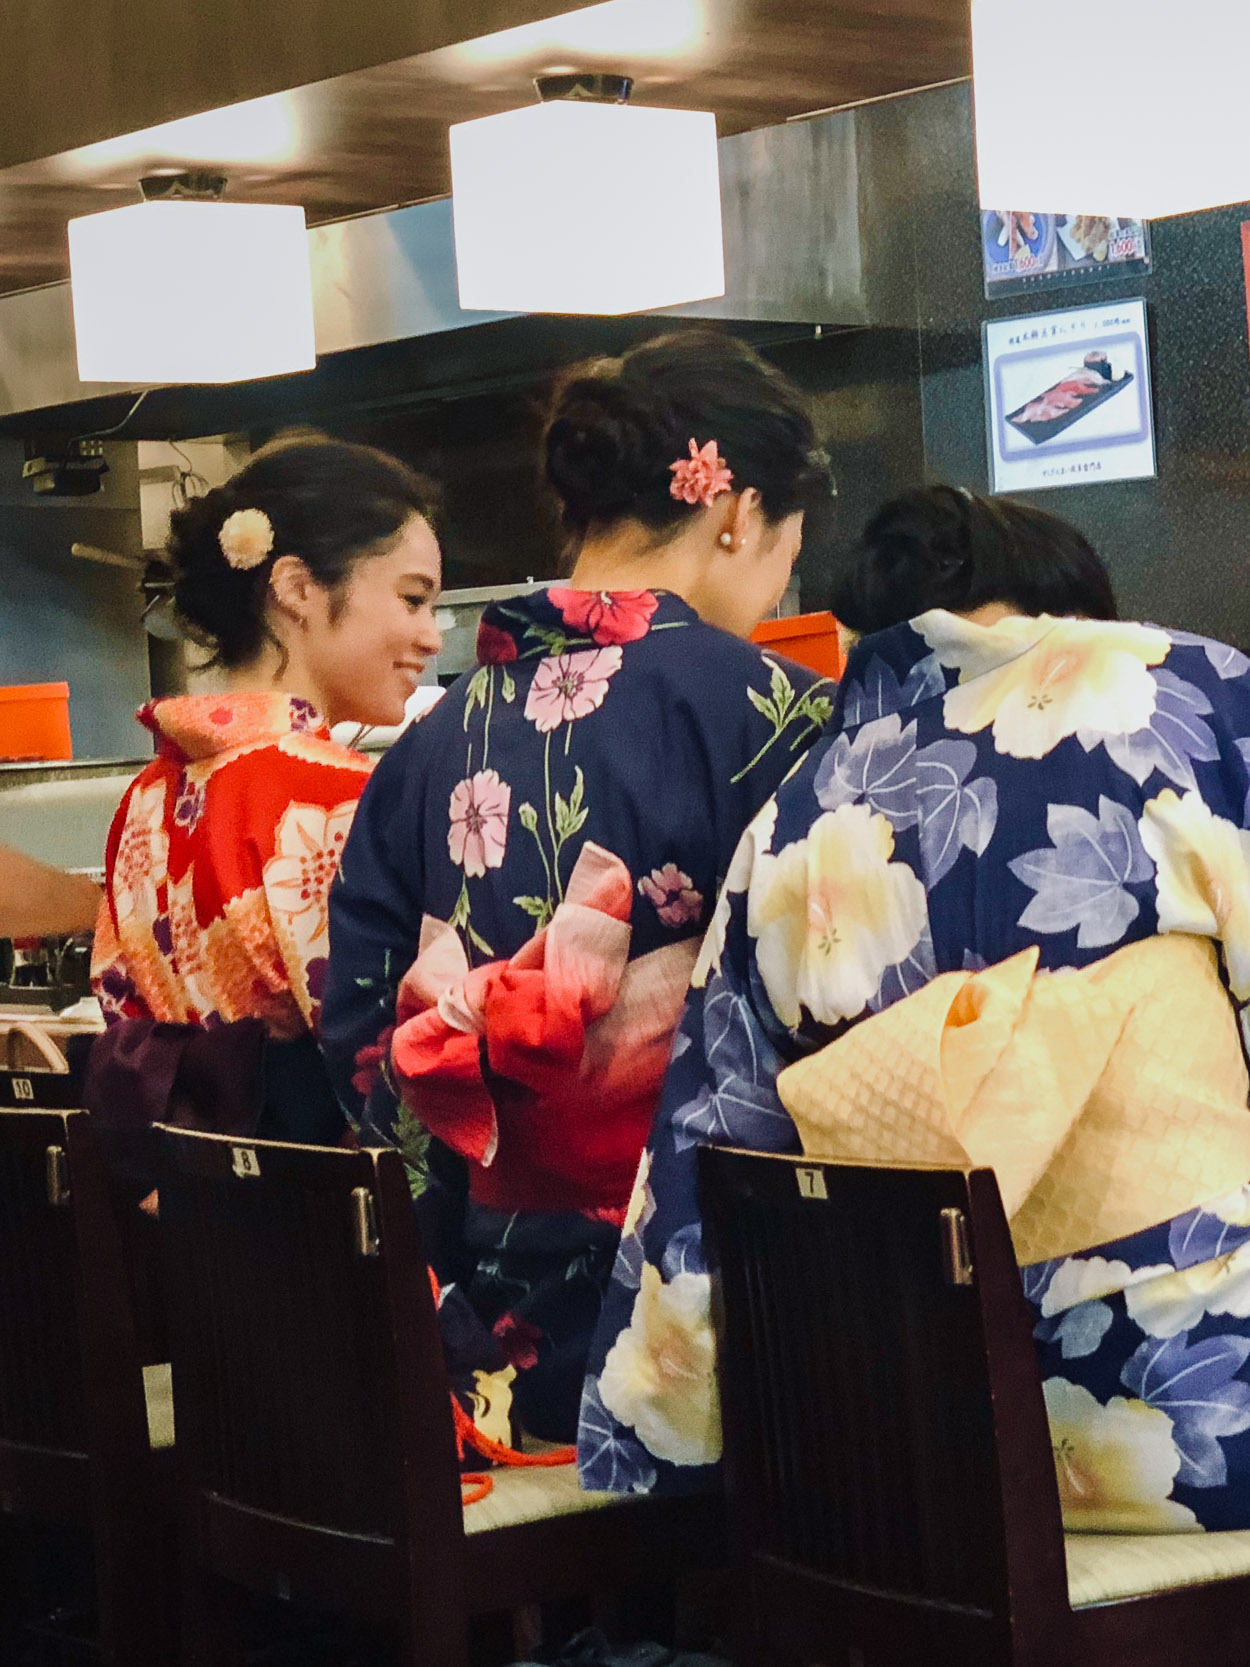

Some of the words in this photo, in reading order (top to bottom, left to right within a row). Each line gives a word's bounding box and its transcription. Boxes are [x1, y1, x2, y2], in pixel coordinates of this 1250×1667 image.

[15, 1079, 31, 1097] 10
[241, 1150, 251, 1171] 8
[804, 1171, 814, 1195] 7
